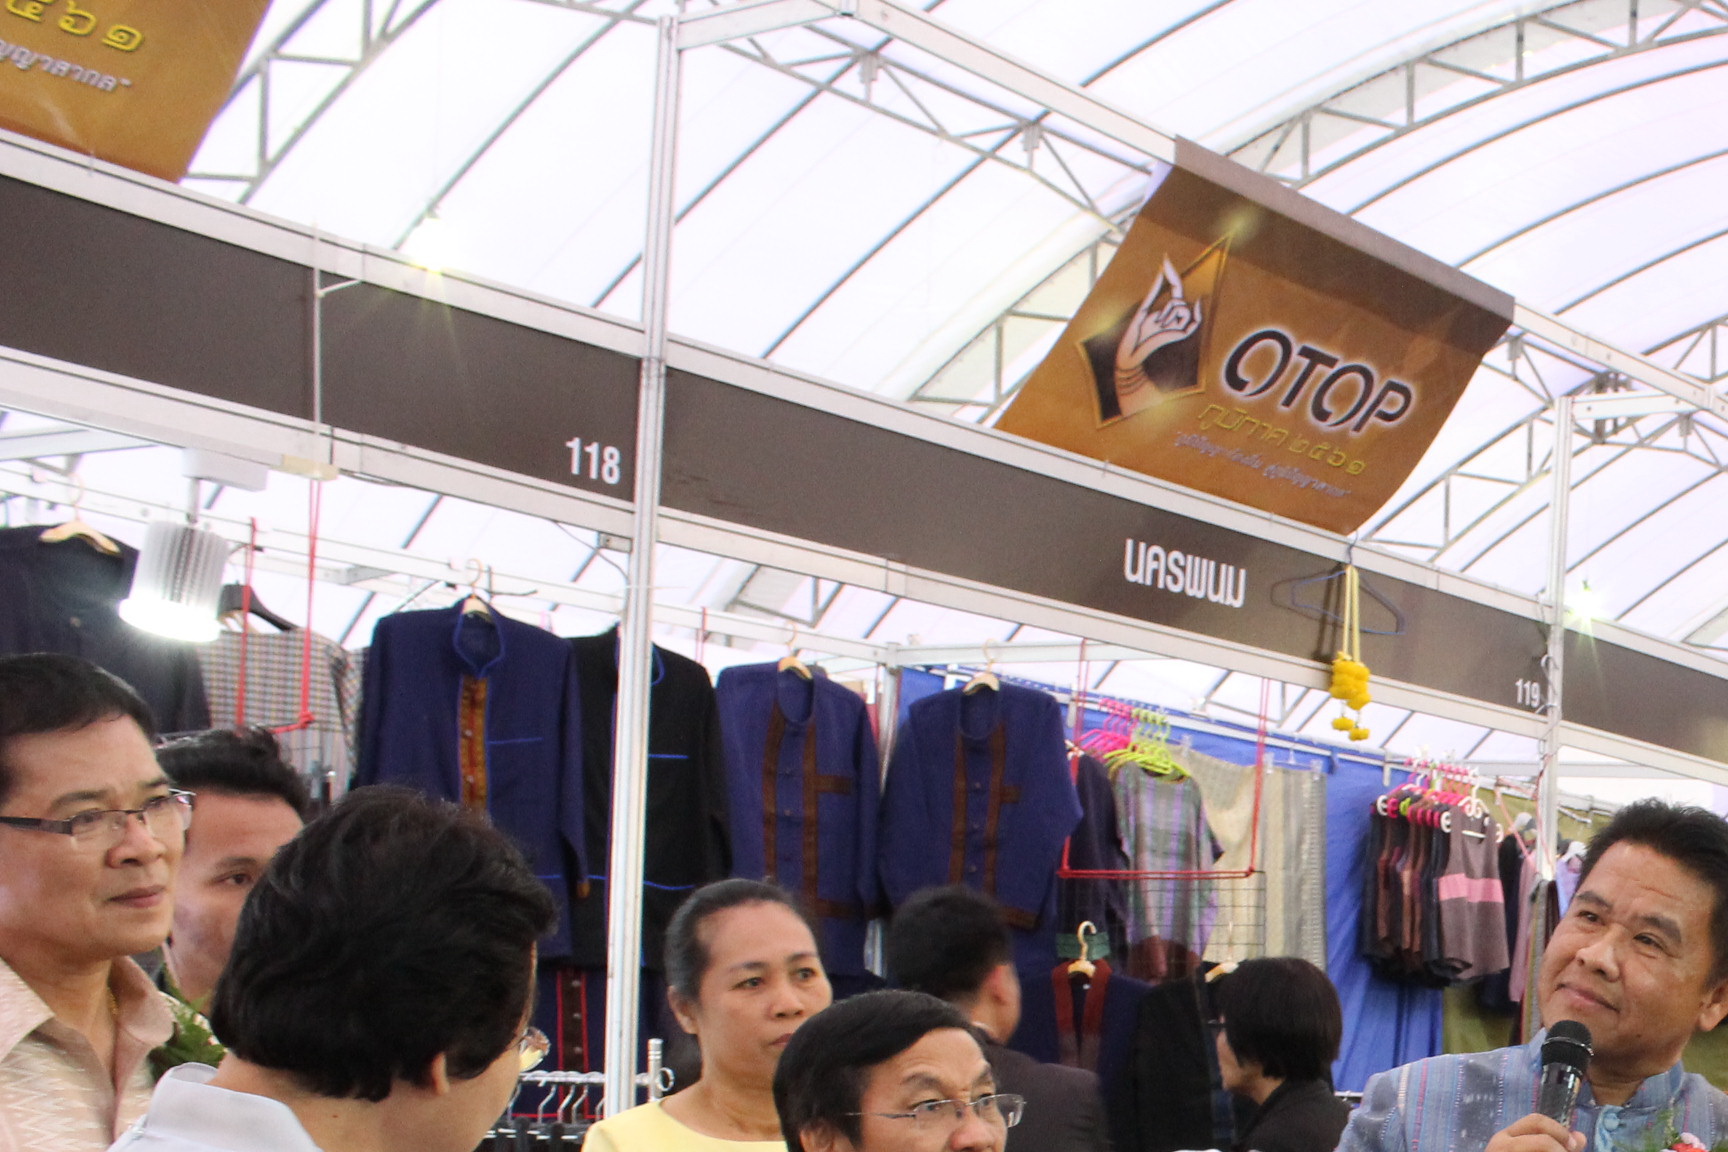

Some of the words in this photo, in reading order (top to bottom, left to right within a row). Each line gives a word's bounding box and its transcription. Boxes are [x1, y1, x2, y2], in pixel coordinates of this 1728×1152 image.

[1223, 329, 1413, 433] OTOP
[565, 436, 621, 486] 118
[1123, 538, 1247, 608] นครพนม
[1515, 678, 1541, 708] 119
